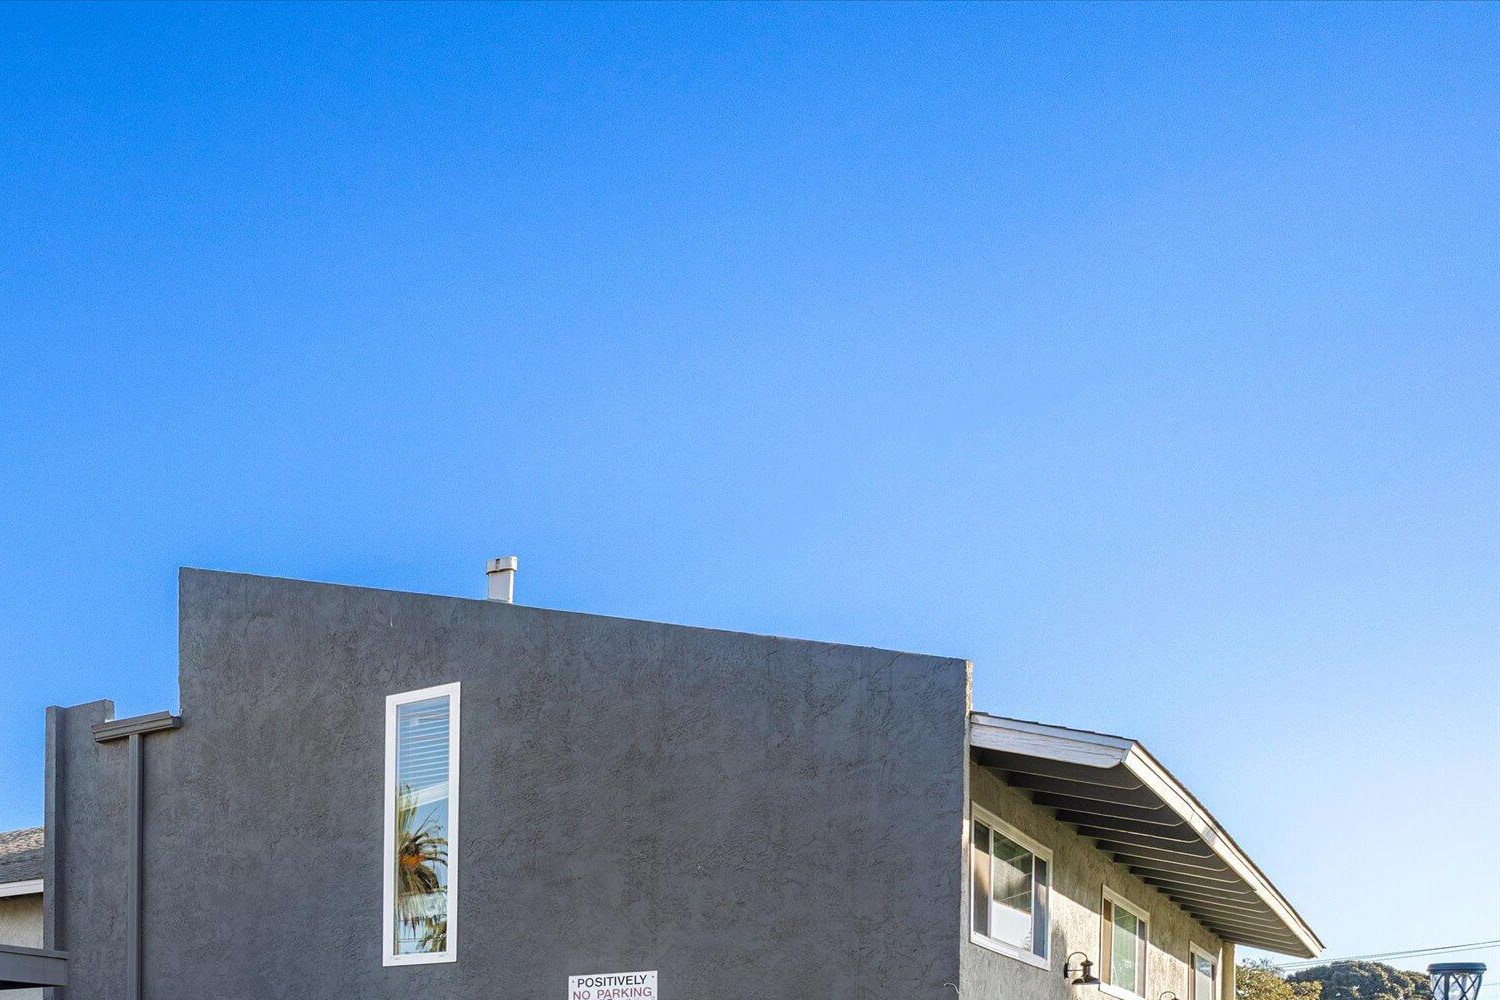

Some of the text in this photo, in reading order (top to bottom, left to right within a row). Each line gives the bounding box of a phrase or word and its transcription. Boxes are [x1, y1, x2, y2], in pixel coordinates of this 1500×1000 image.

[577, 975, 647, 988] POSITIVELY
[573, 987, 652, 1000] NO PARKING
